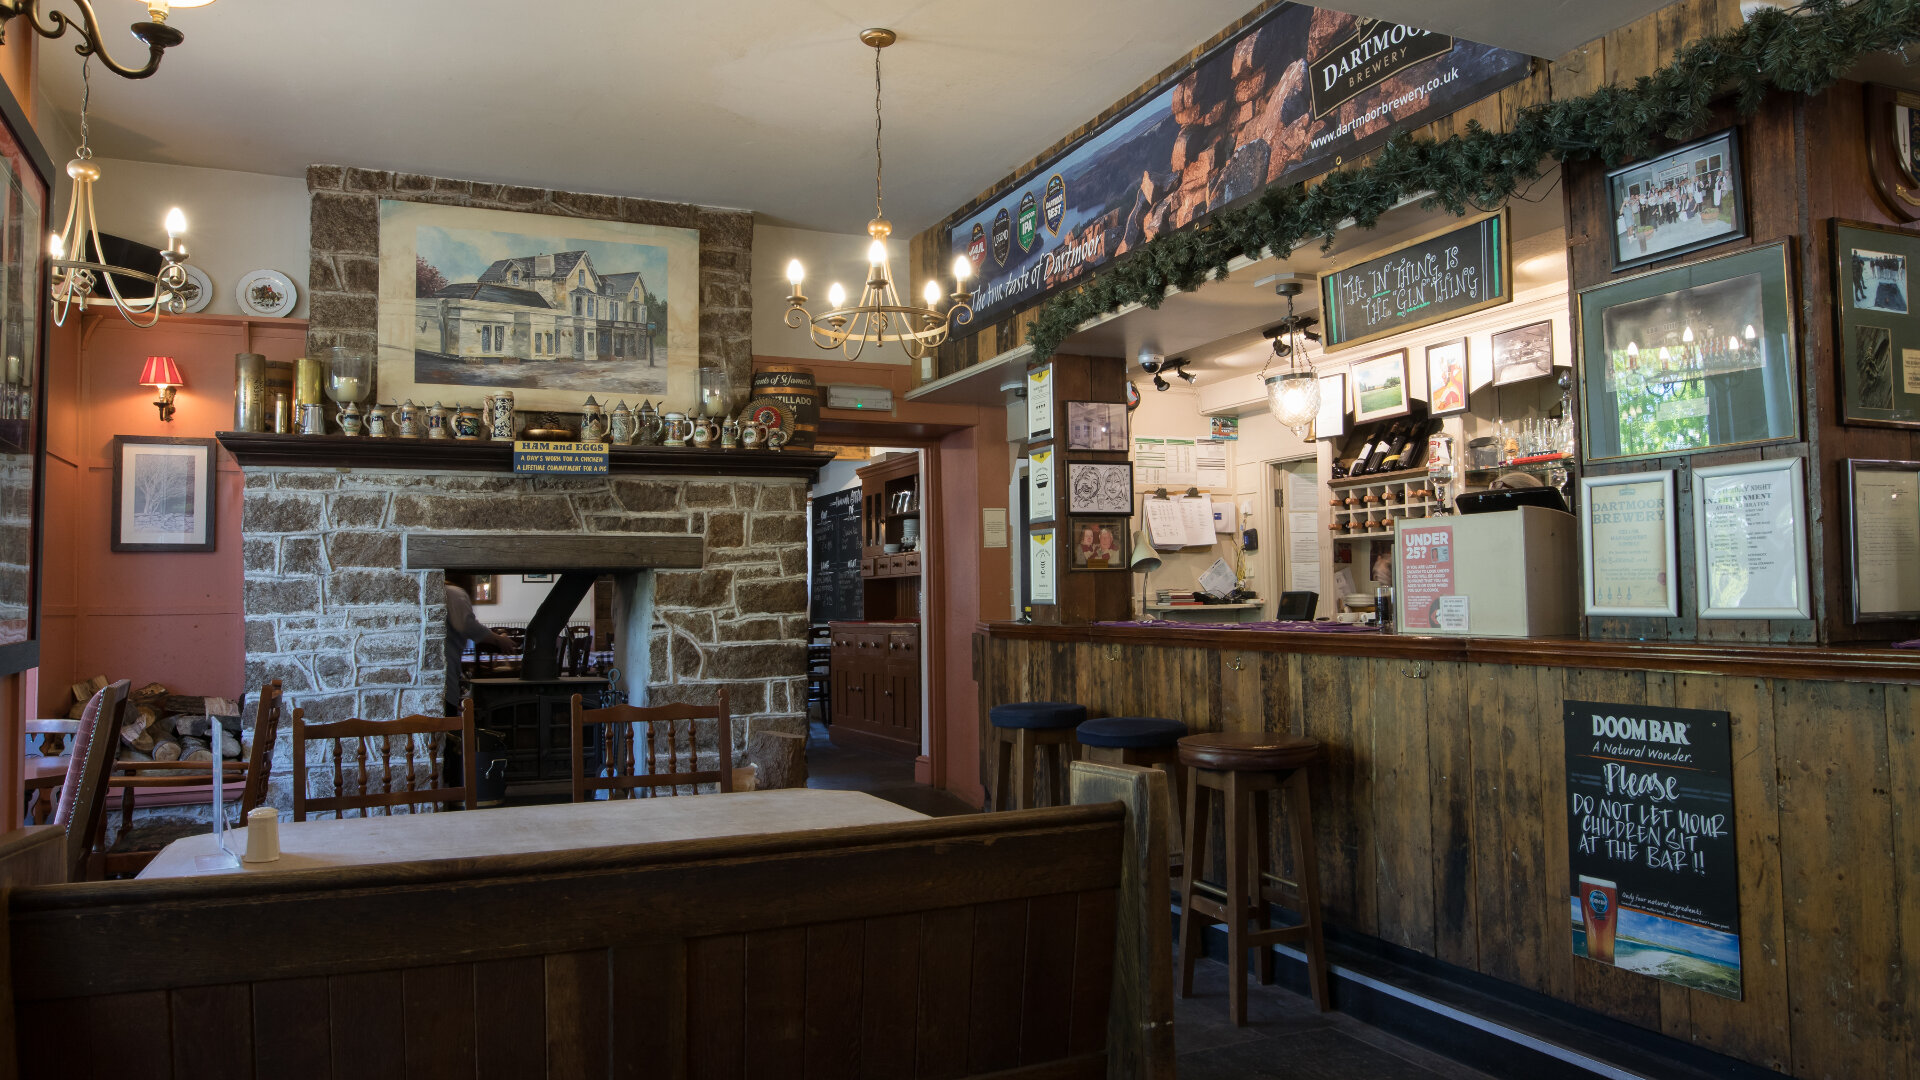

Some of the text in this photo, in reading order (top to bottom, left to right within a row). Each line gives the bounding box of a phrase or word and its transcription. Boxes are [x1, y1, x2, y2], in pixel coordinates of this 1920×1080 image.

[1323, 23, 1432, 92] DARTMOO
[1350, 47, 1407, 88] BREWERY
[1310, 67, 1460, 150] www.dartmoorbrewery.co.uk
[1047, 204, 1062, 220] BEST
[1022, 222, 1033, 235] IPA
[969, 242, 984, 256] JAIL
[971, 234, 1103, 312] The true taste of Dartmoor
[1343, 275, 1367, 305] THE
[1393, 253, 1440, 288] THING
[1445, 246, 1459, 271] IS
[1362, 297, 1391, 326] THE
[1431, 266, 1479, 303] THING
[770, 375, 780, 385] of
[522, 442, 604, 452] HAM and EGGS
[547, 464, 581, 472] COMMITMENT
[1750, 483, 1772, 492] NIGHT
[1592, 499, 1664, 512] DARTMOOR
[1593, 510, 1664, 524] BREWERY
[1406, 532, 1448, 546] UNDER
[1406, 546, 1427, 559] 25?
[1592, 714, 1692, 745] DOOM BAR
[1592, 741, 1693, 763] A Natural Wonder.
[1603, 762, 1680, 800] Please
[1573, 792, 1728, 838] DO NOT LET YOUR
[1582, 814, 1698, 851] CHILDREN SIT
[1579, 833, 1600, 854] AT
[1605, 839, 1639, 860] THE
[1622, 892, 1635, 903] Only
[1636, 894, 1647, 903] four
[1647, 898, 1670, 908] natural
